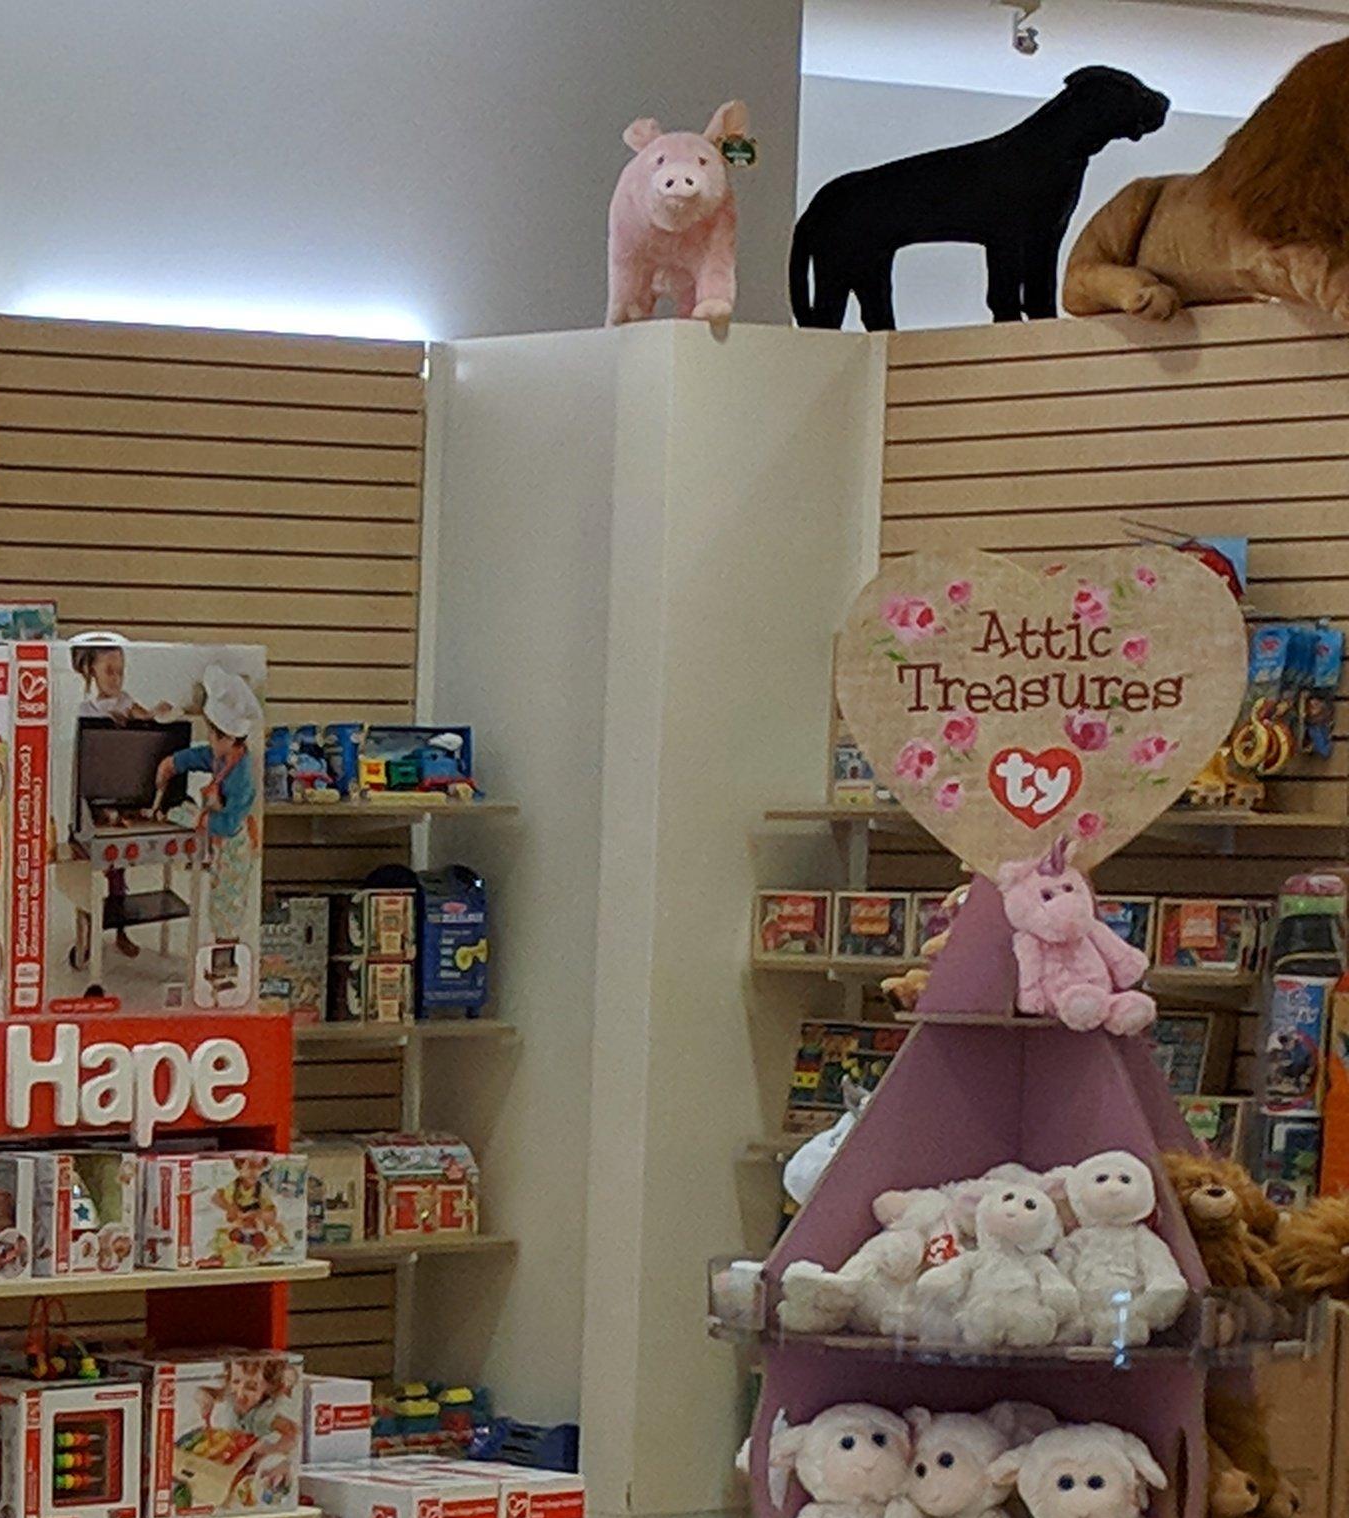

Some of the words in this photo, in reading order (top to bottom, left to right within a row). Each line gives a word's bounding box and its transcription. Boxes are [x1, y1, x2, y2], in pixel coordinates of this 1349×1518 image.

[971, 609, 1113, 661] Attic
[897, 663, 1185, 713] Treasures
[995, 752, 1071, 815] ty
[6, 1023, 250, 1148] Hape
